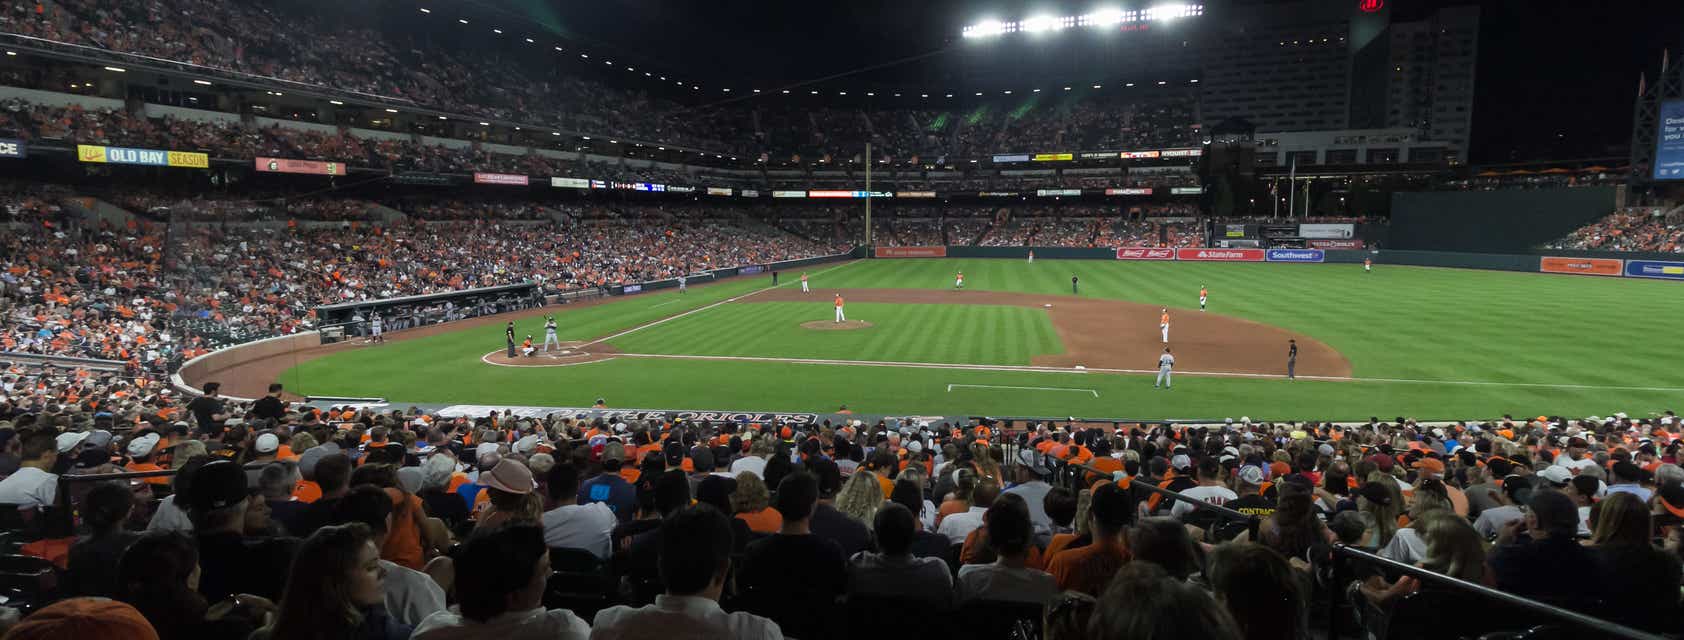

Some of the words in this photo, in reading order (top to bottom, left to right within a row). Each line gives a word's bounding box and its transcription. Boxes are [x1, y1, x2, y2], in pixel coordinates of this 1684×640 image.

[110, 149, 136, 162] OLD
[139, 150, 164, 164] BAY
[171, 153, 207, 167] SEASON
[1272, 251, 1313, 259] Southwest
[676, 411, 807, 424] ORIOLES
